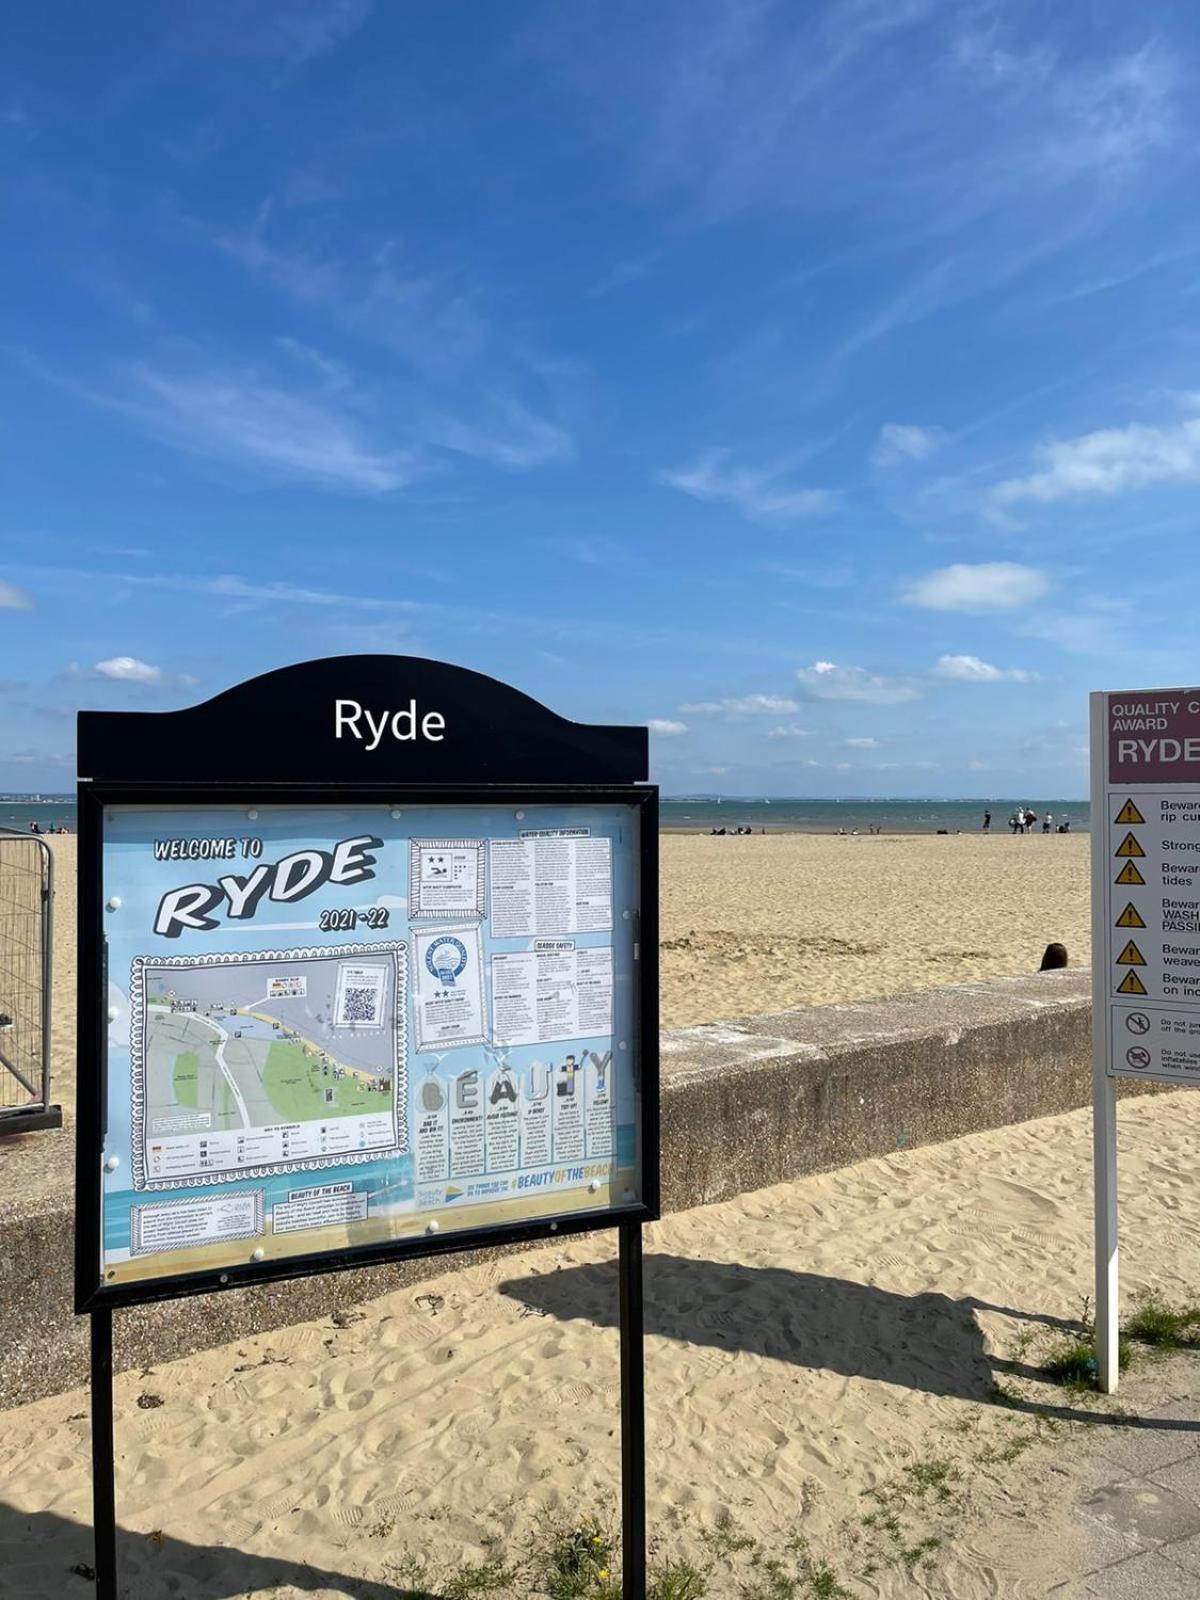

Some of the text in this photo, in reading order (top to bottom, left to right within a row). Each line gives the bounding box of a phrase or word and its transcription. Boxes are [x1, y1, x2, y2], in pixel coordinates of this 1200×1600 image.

[1112, 702, 1180, 717] QUALITY
[336, 699, 445, 751] Ryde
[1112, 718, 1168, 731] AWARD
[1118, 737, 1200, 763] RYDE
[1161, 812, 1177, 823] rip
[154, 837, 263, 861] WELCOME TO
[153, 834, 385, 938] RYDE
[1162, 875, 1193, 886] tides
[1162, 910, 1200, 921] WASH
[1163, 986, 1178, 995] on
[1160, 1018, 1172, 1026] Do
[1173, 1020, 1186, 1029] not
[1173, 1050, 1187, 1058] not
[291, 1184, 351, 1200] BEAUTY OF THE BEACH
